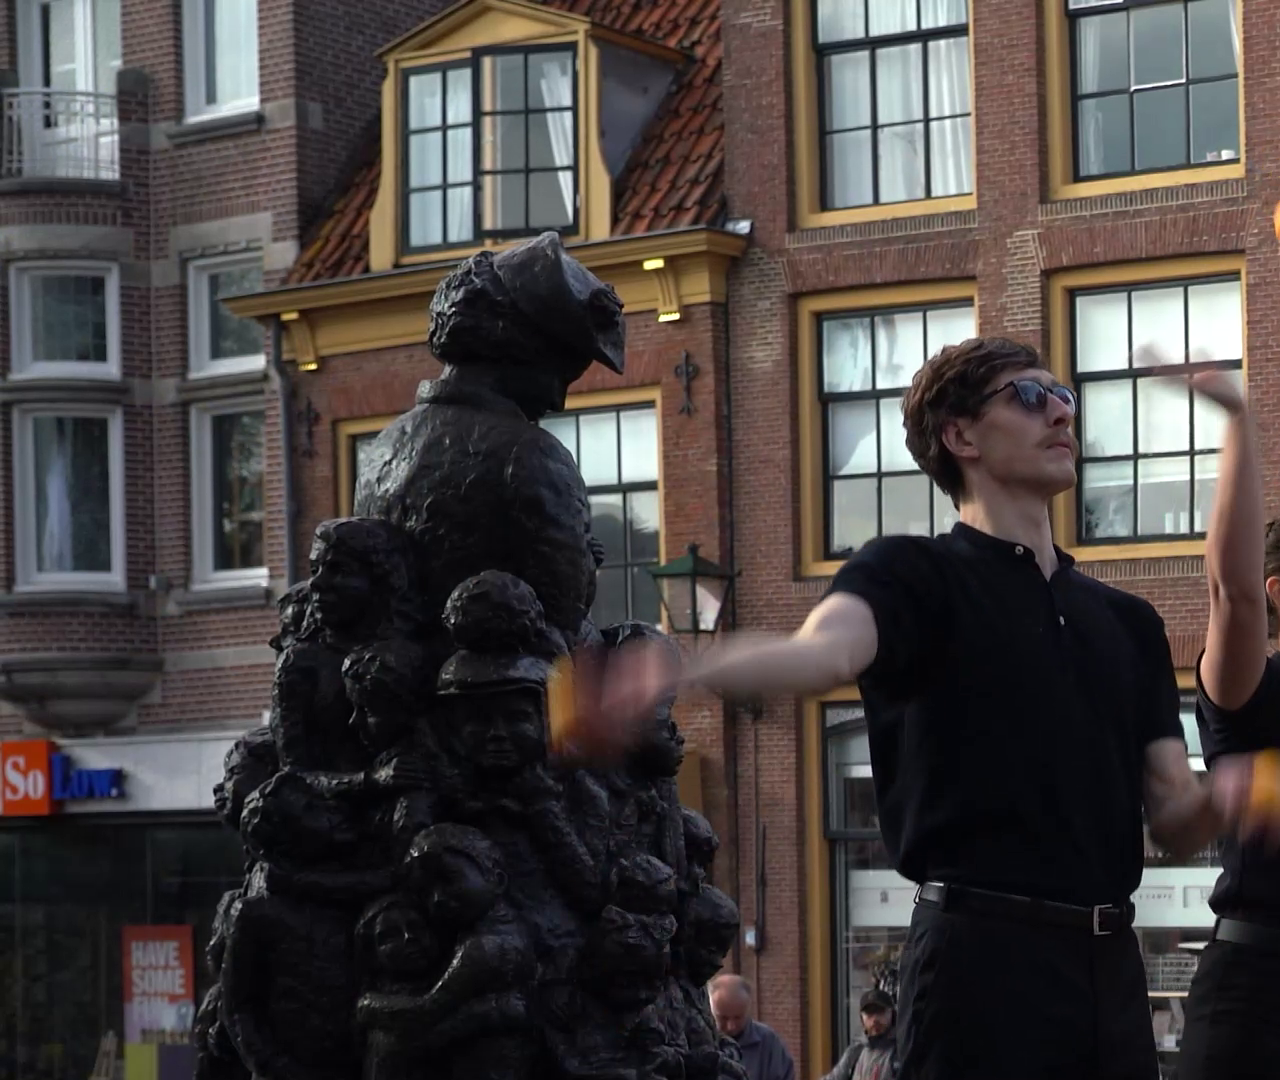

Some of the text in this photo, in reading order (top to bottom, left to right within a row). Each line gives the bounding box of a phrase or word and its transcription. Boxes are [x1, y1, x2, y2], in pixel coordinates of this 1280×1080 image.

[4, 755, 45, 800] So
[131, 940, 181, 966] HAVE
[131, 968, 186, 995] SOME
